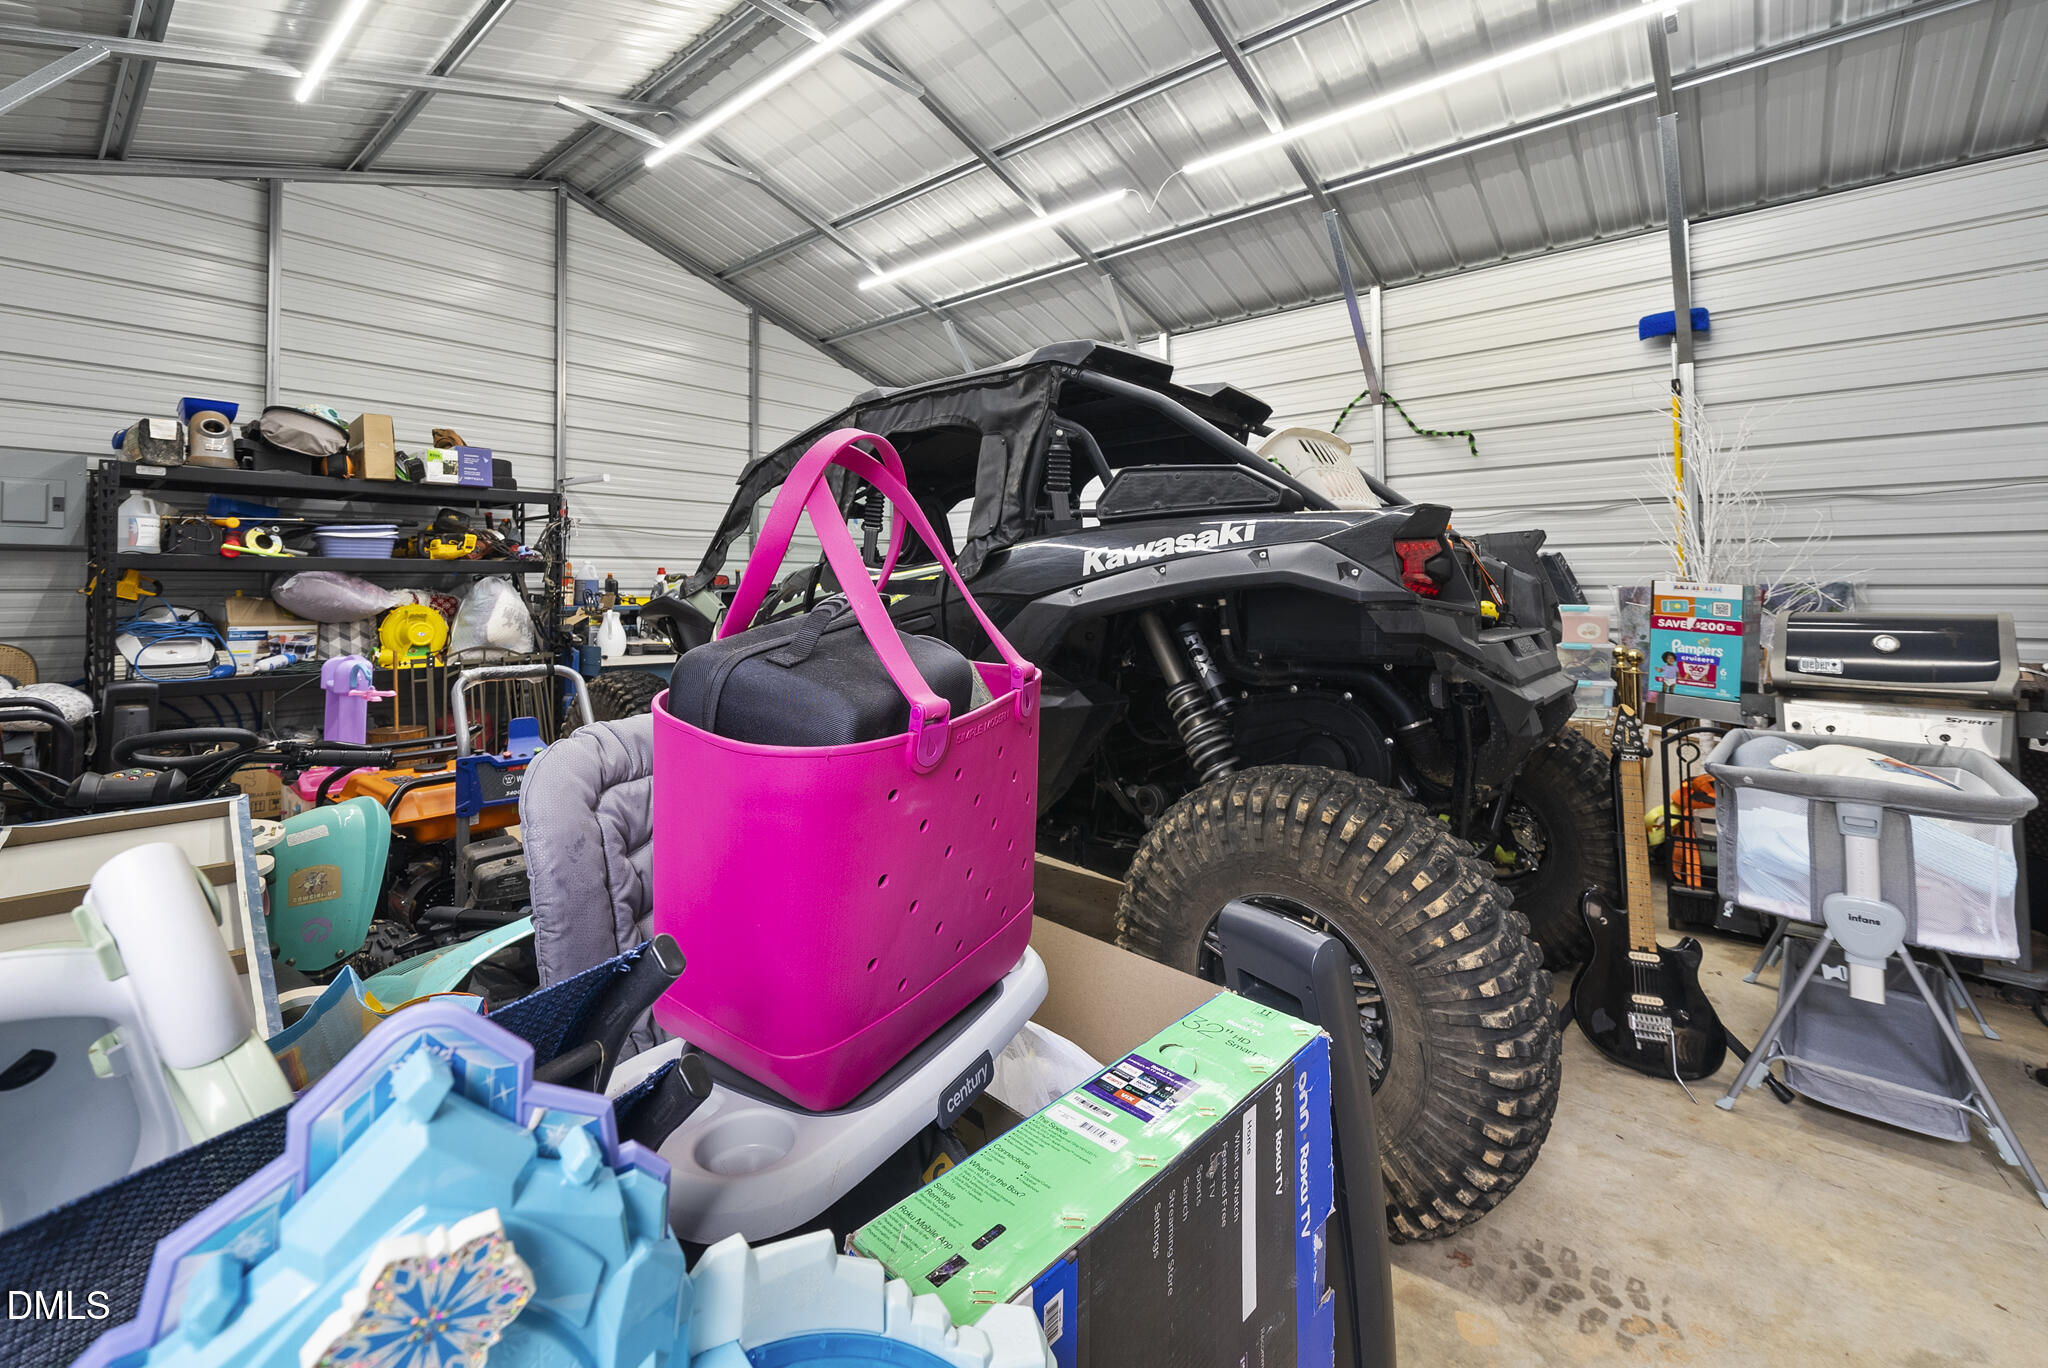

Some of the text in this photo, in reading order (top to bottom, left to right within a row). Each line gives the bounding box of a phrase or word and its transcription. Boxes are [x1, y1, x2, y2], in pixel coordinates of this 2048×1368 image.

[1082, 519, 1257, 577] Kawasaki
[1658, 618, 1688, 629] SAVE
[1695, 621, 1726, 632] $200
[1183, 632, 1218, 679] FOX
[1671, 639, 1724, 657] Pampers
[1681, 655, 1715, 664] cruisers
[1720, 668, 1728, 677] 6
[1800, 657, 1831, 670] weber
[1945, 717, 1998, 726] SPIRIT
[1848, 913, 1881, 926] infans
[1181, 1014, 1251, 1045] 32" HD
[1241, 1016, 1265, 1029] onn
[1250, 1028, 1265, 1038] TV
[1225, 1039, 1259, 1057] Smart
[946, 1063, 988, 1113] century
[1274, 1083, 1283, 1121] onn
[1037, 1115, 1050, 1125] The
[1049, 1121, 1068, 1136] Specs
[994, 1144, 1031, 1169] Connections
[1233, 1130, 1241, 1164] What
[1298, 1072, 1311, 1238] onn Roku TV
[969, 1160, 990, 1176] What's
[996, 1178, 1008, 1188] the
[1007, 1185, 1026, 1198] Box?
[1196, 1164, 1204, 1207] Sports
[1209, 1182, 1216, 1199] TV
[1275, 1173, 1282, 1196] TV
[925, 1189, 950, 1209] Remote
[934, 1183, 956, 1201] Simple
[1182, 1176, 1190, 1223] Search
[899, 1205, 916, 1221] Roku
[915, 1218, 938, 1238] Mobile
[938, 1236, 953, 1250] App
[1152, 1202, 1161, 1259] Settings
[1167, 1189, 1176, 1297] Streaming Store
